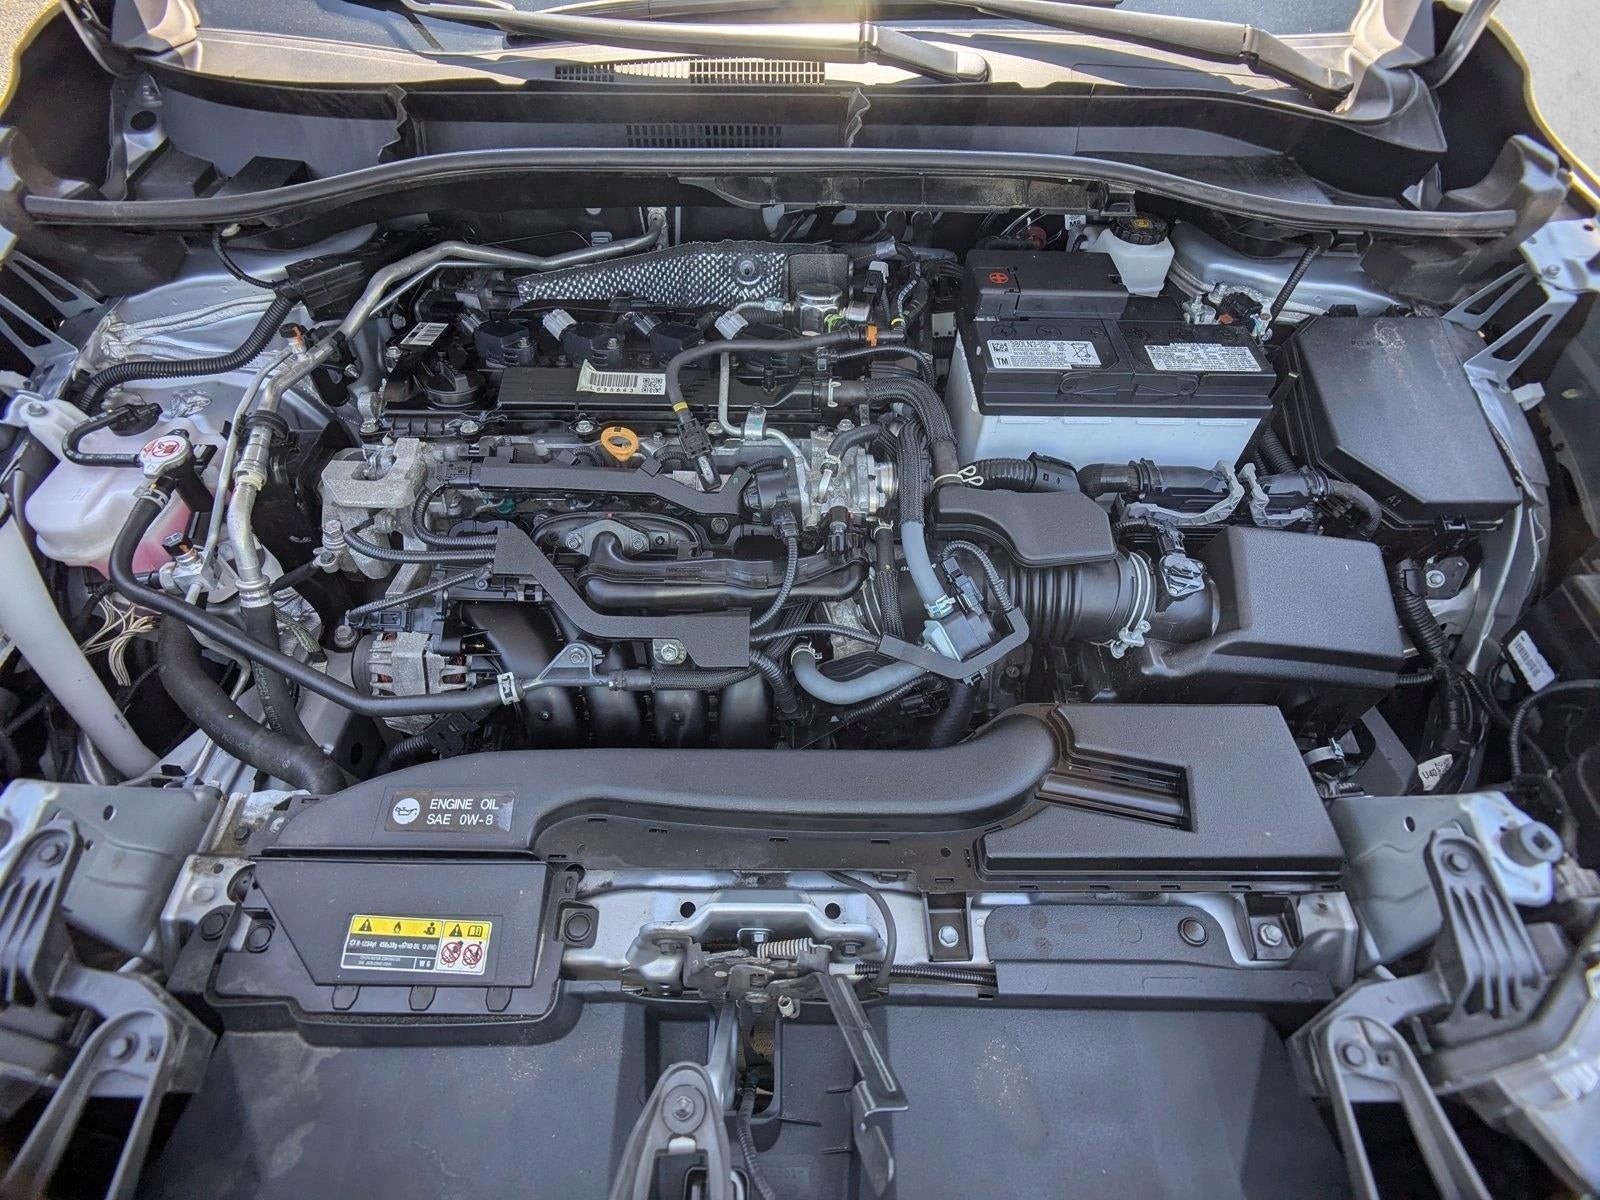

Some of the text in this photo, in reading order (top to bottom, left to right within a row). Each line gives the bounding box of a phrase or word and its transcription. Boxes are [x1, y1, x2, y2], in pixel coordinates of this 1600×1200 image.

[996, 358, 1009, 366] TM
[429, 798, 500, 810] ENGINE OIL
[426, 813, 494, 826] SAE 0W-8
